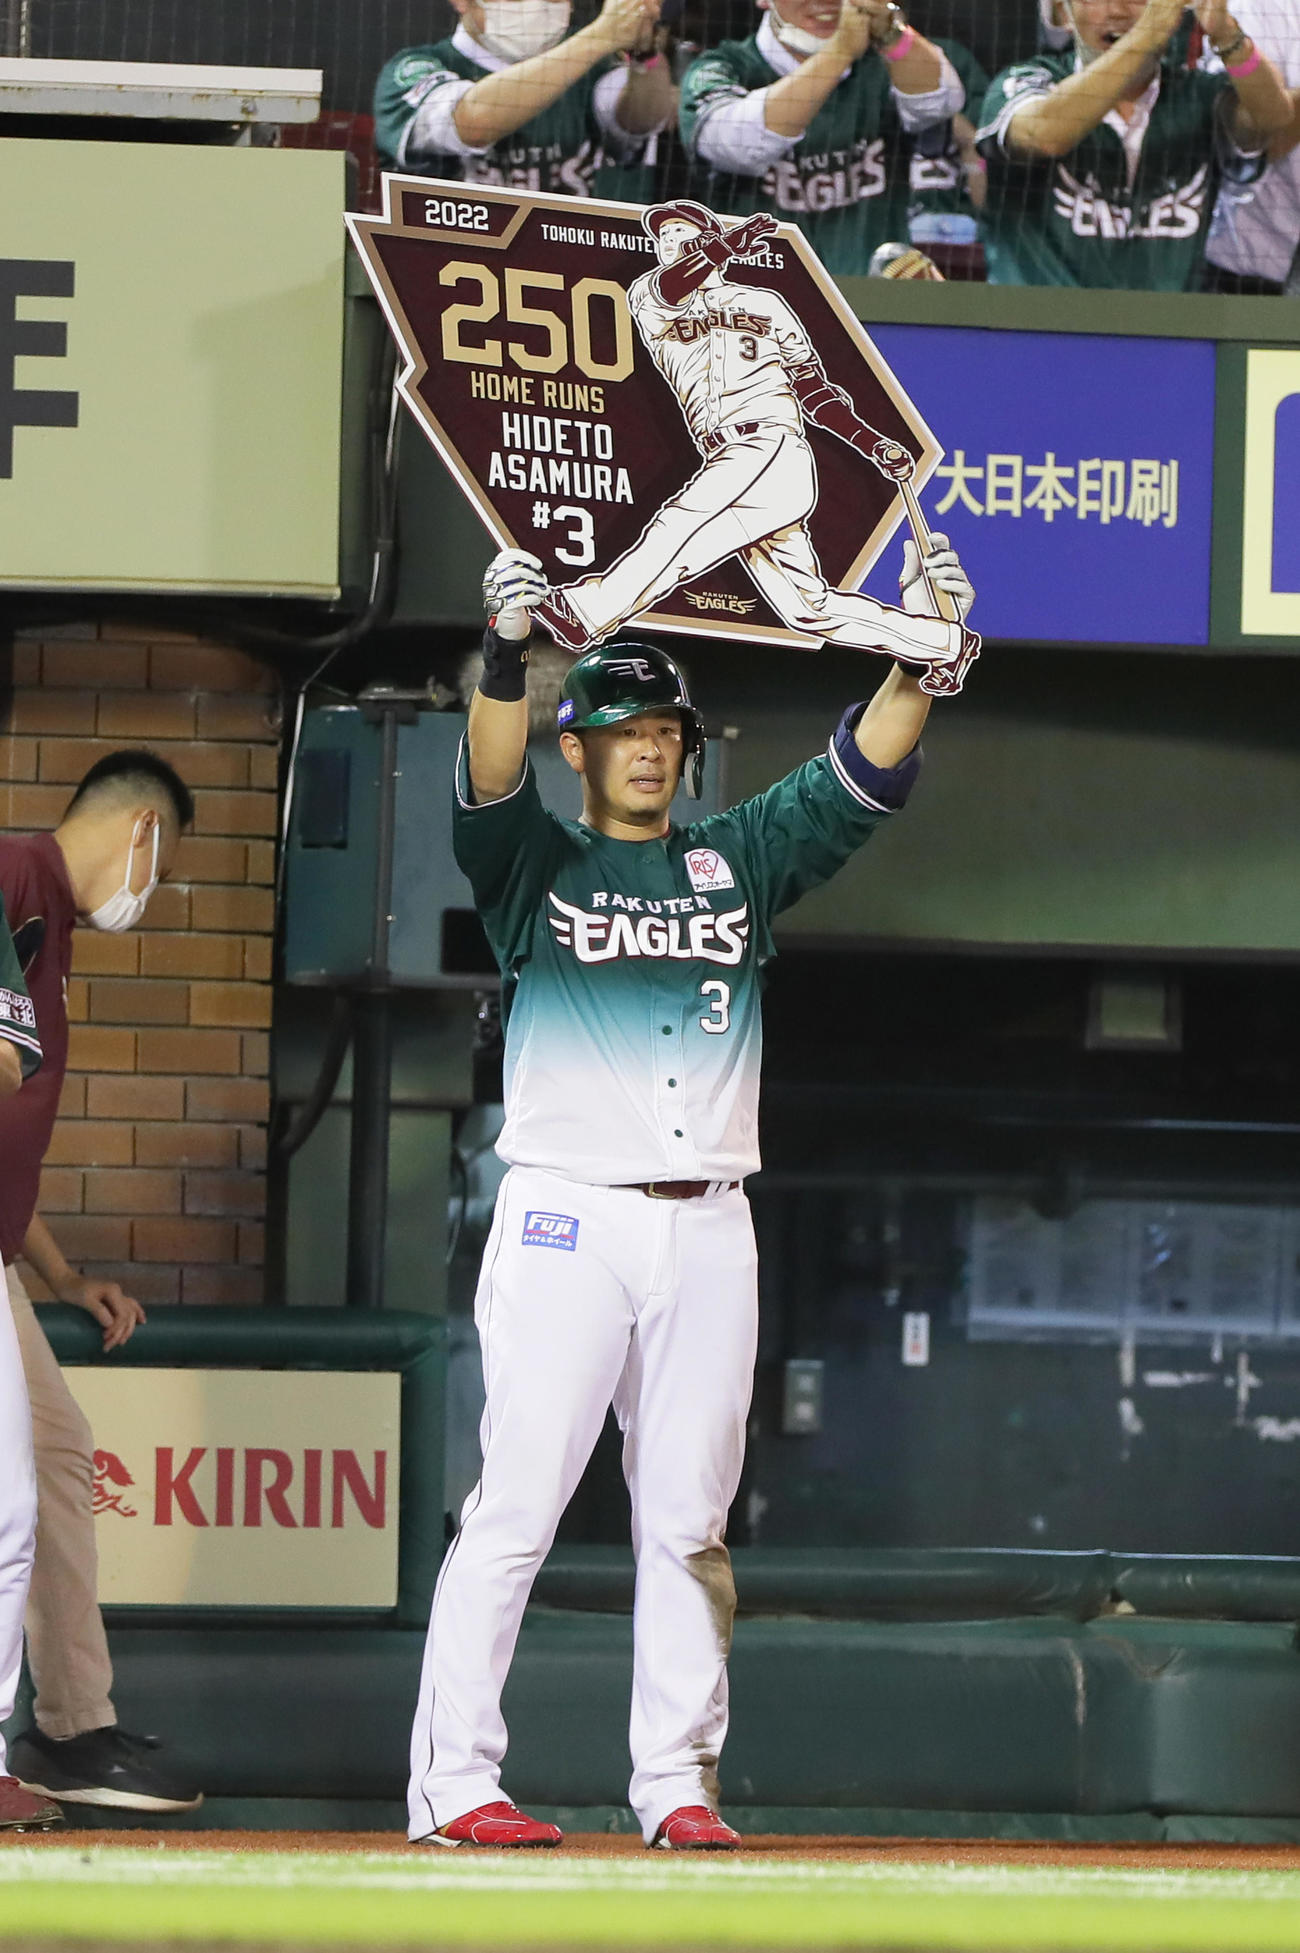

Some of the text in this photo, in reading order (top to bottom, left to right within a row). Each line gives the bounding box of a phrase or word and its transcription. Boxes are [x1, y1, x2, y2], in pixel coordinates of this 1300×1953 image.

[424, 200, 489, 231] 2022
[541, 223, 595, 246] TOHOKU
[438, 260, 635, 383] 250
[739, 335, 759, 362] 3
[471, 371, 605, 414] HOME RUNS
[502, 411, 613, 460] HIDETO
[488, 451, 635, 504] ASAMURA
[934, 449, 1179, 528] 大日本印刷
[686, 594, 755, 614] EAGLES
[702, 591, 739, 600] RAKUTEN
[592, 891, 712, 915] RAKUTEN
[549, 898, 749, 966] EAGLES
[699, 979, 730, 1034] 3
[153, 1446, 388, 1529] KIRIN
